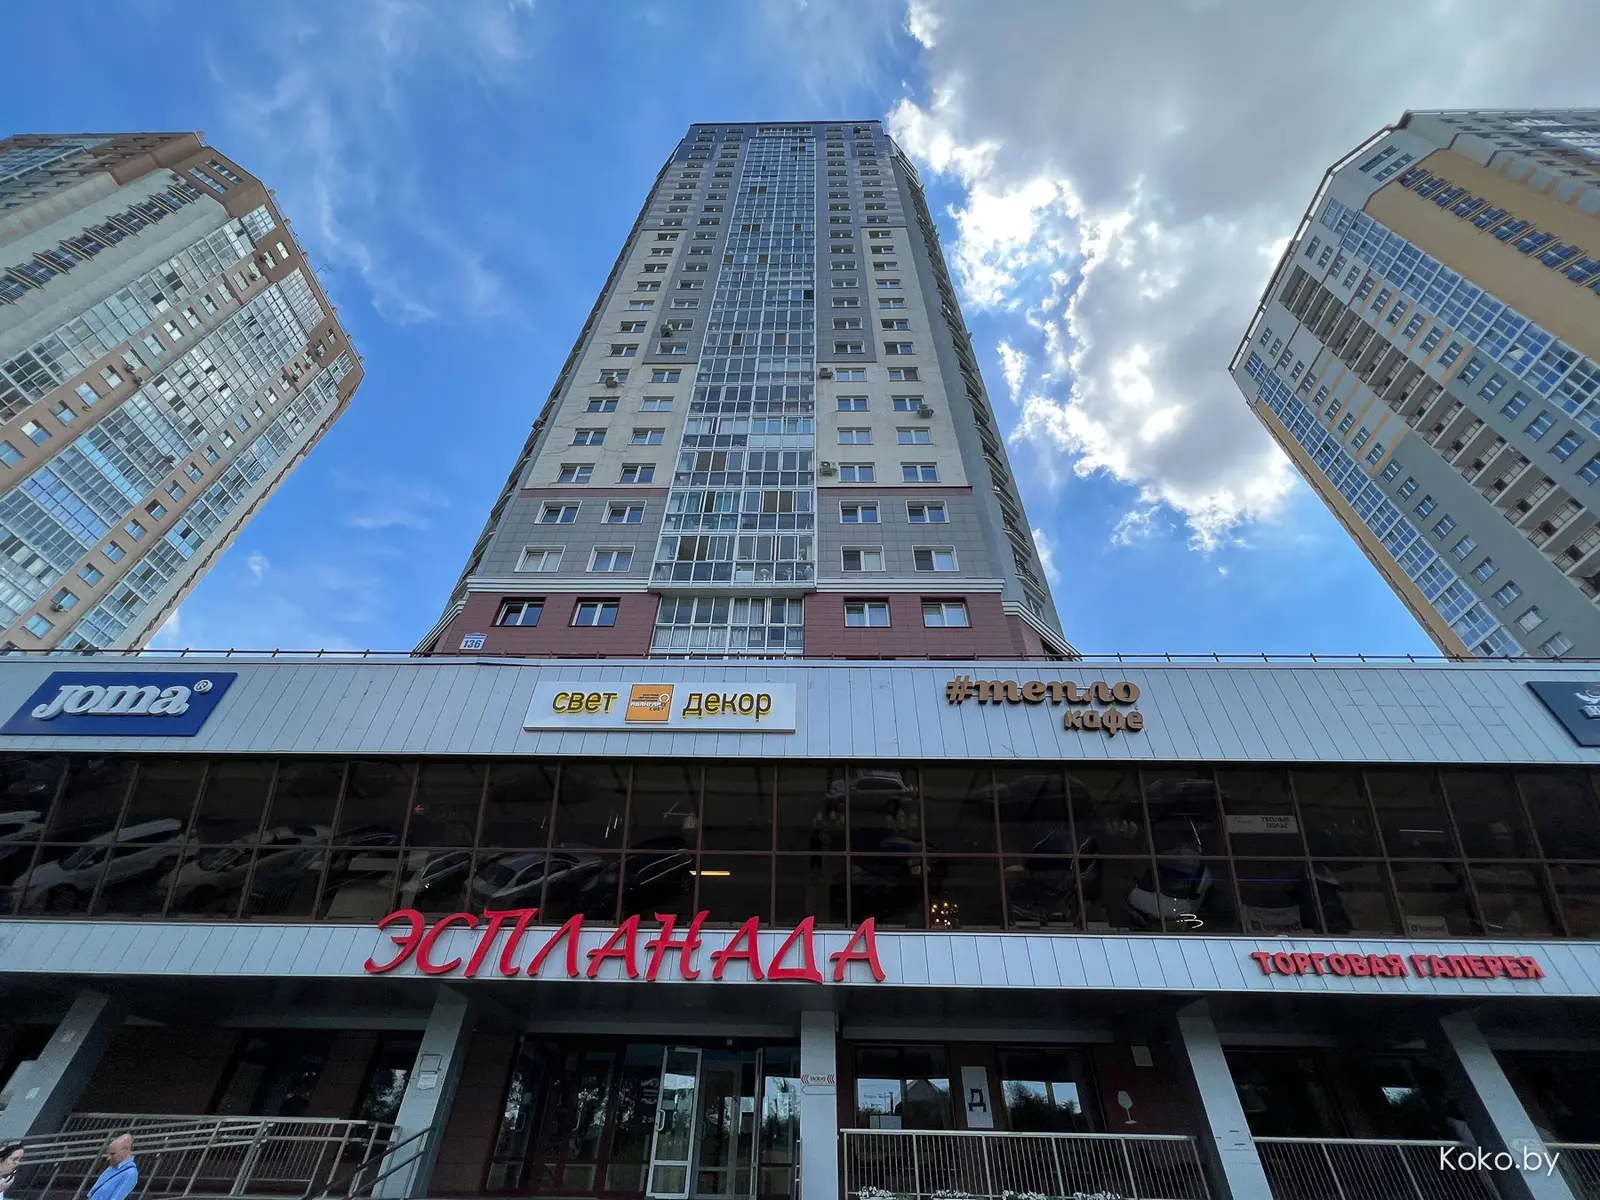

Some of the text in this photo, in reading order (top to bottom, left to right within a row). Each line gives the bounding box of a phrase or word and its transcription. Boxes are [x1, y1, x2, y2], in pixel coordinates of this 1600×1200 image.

[463, 639, 482, 649] 136
[552, 691, 772, 721] свет декор
[1064, 707, 1144, 737] кафе
[364, 908, 886, 984] ЭСПЛАНАДА
[1250, 951, 1547, 980] ТОРГОВАЯ ГАЛЕРЕЯ
